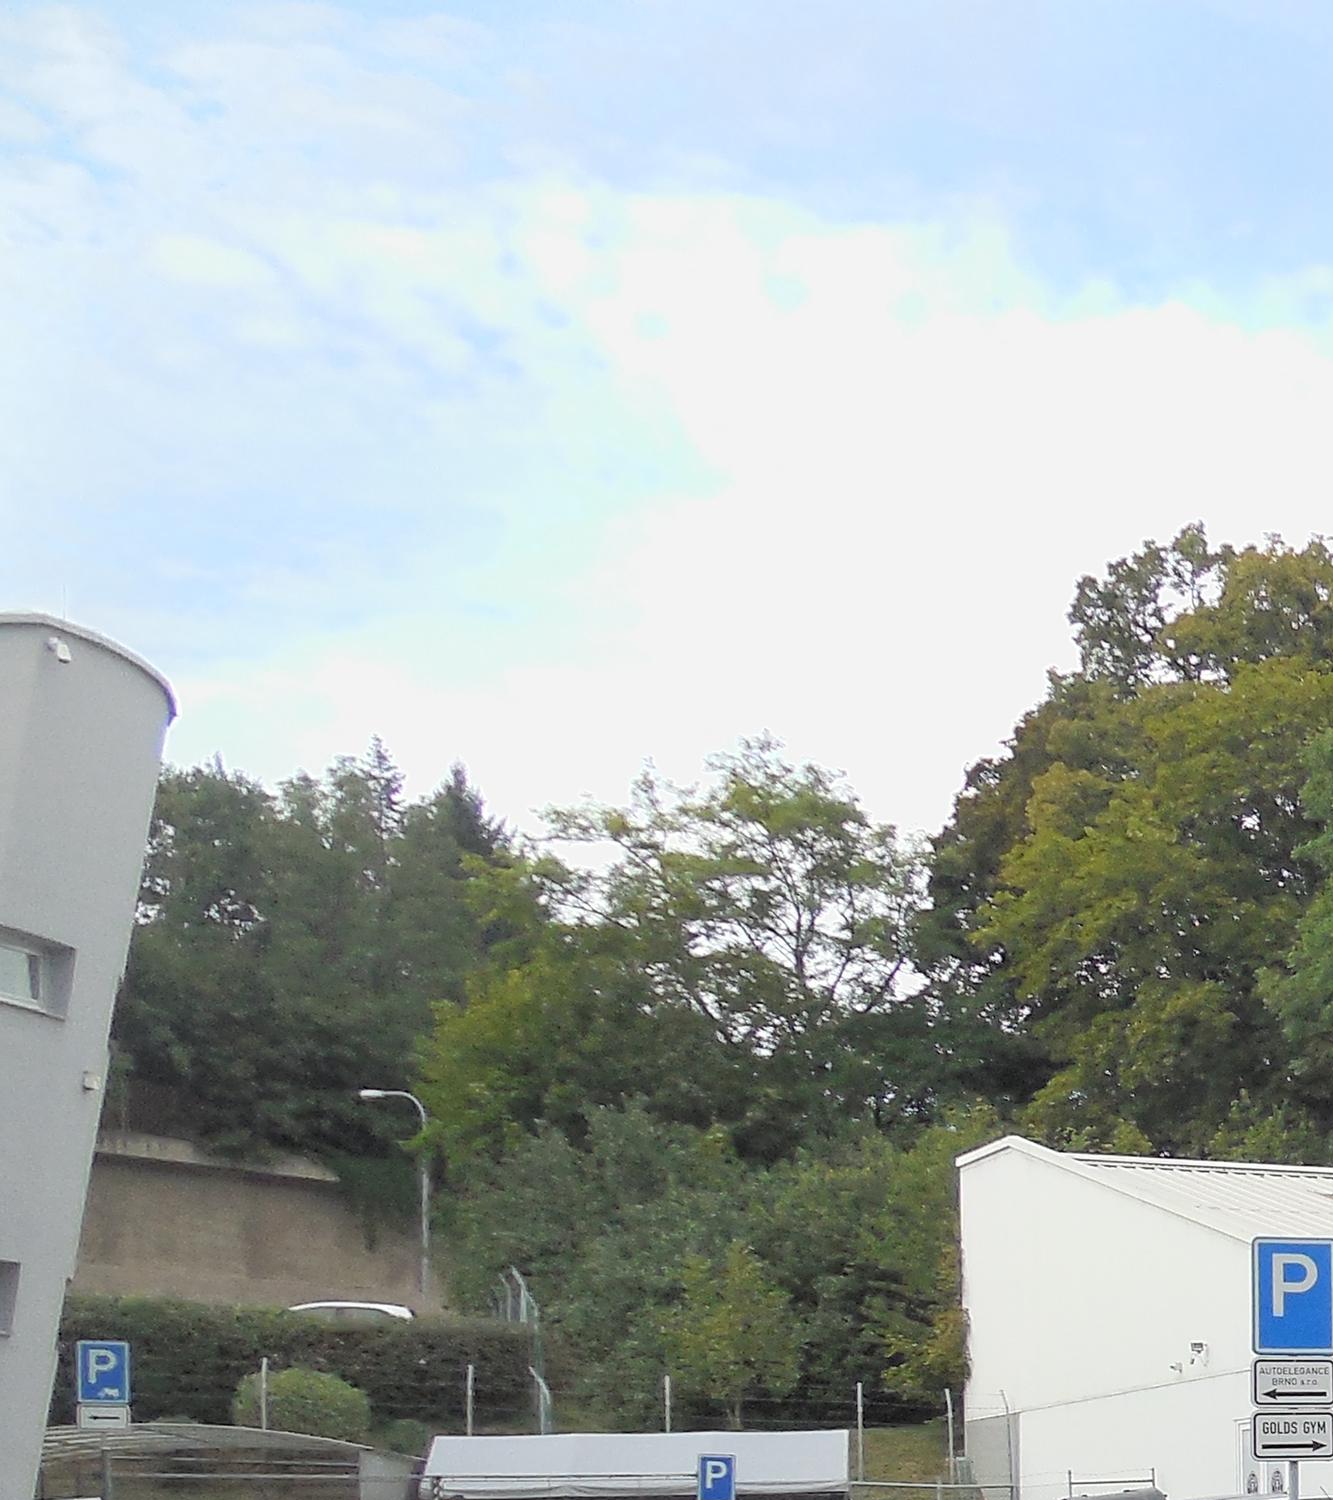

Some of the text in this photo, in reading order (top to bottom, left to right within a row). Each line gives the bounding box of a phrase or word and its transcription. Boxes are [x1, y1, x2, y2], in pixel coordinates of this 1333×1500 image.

[1272, 1253, 1318, 1317] P
[87, 1349, 116, 1384] P
[1259, 1367, 1329, 1375] AUTOELEGANCE
[1272, 1378, 1297, 1386] BRNO
[1262, 1421, 1326, 1434] GOLDS GYM
[706, 1461, 727, 1489] P
